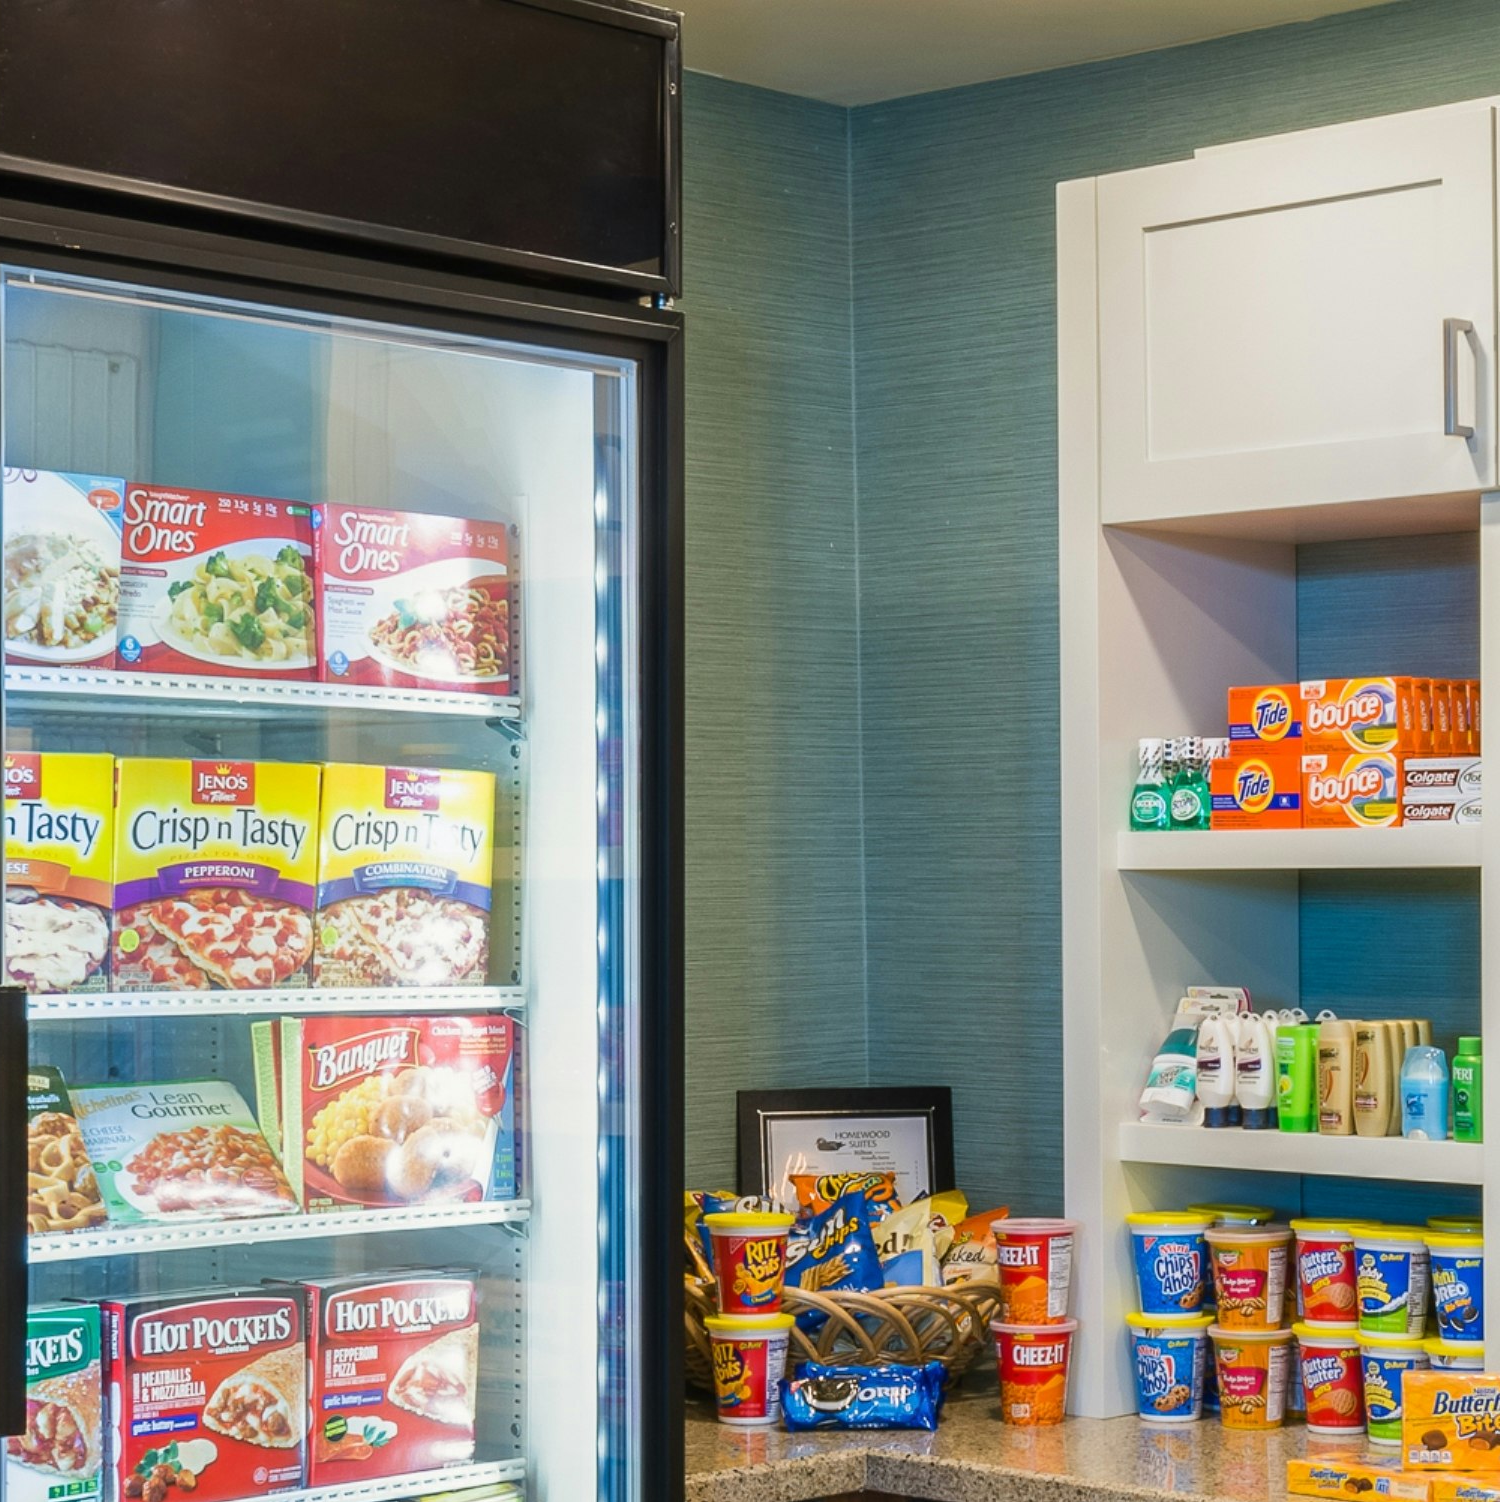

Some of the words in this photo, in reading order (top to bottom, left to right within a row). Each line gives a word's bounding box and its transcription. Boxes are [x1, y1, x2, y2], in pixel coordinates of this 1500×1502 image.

[123, 490, 206, 527] Smart
[129, 522, 195, 555] Ones
[334, 512, 411, 546] Smart
[340, 543, 402, 573] Ones
[1256, 701, 1288, 731] Tide
[1308, 696, 1380, 732] bounce
[197, 772, 248, 792] JENO'S
[1238, 772, 1270, 802] Tide
[1308, 770, 1379, 804] bounce
[1406, 771, 1456, 786] Colgate
[1404, 805, 1451, 819] Colgate
[22, 803, 100, 857] Tasty
[131, 809, 210, 852] Crisp
[237, 807, 306, 860] Tasty
[184, 865, 255, 880] PEPPERONI
[365, 863, 447, 879] COMBINATION
[316, 1033, 410, 1086] Banquet
[149, 1092, 203, 1105] Lean
[132, 1103, 230, 1120] Gourmet
[835, 1130, 891, 1140] HOMEWOOD
[849, 1140, 877, 1148] SUITES
[746, 1238, 778, 1265] RITZ
[1160, 1243, 1189, 1255] Mini
[1157, 1254, 1194, 1278] Chips
[1162, 1253, 1199, 1292] Ahoy!
[1303, 1262, 1341, 1282] Butter
[335, 1301, 377, 1333] HOT
[380, 1287, 469, 1328] POCKETS
[143, 1321, 193, 1355] HOT
[198, 1308, 291, 1348] POCKETS
[1013, 1343, 1064, 1366] CHEEZ-IT
[141, 1368, 191, 1384] MEATBALLS
[152, 1382, 206, 1400] MOZZARELLA
